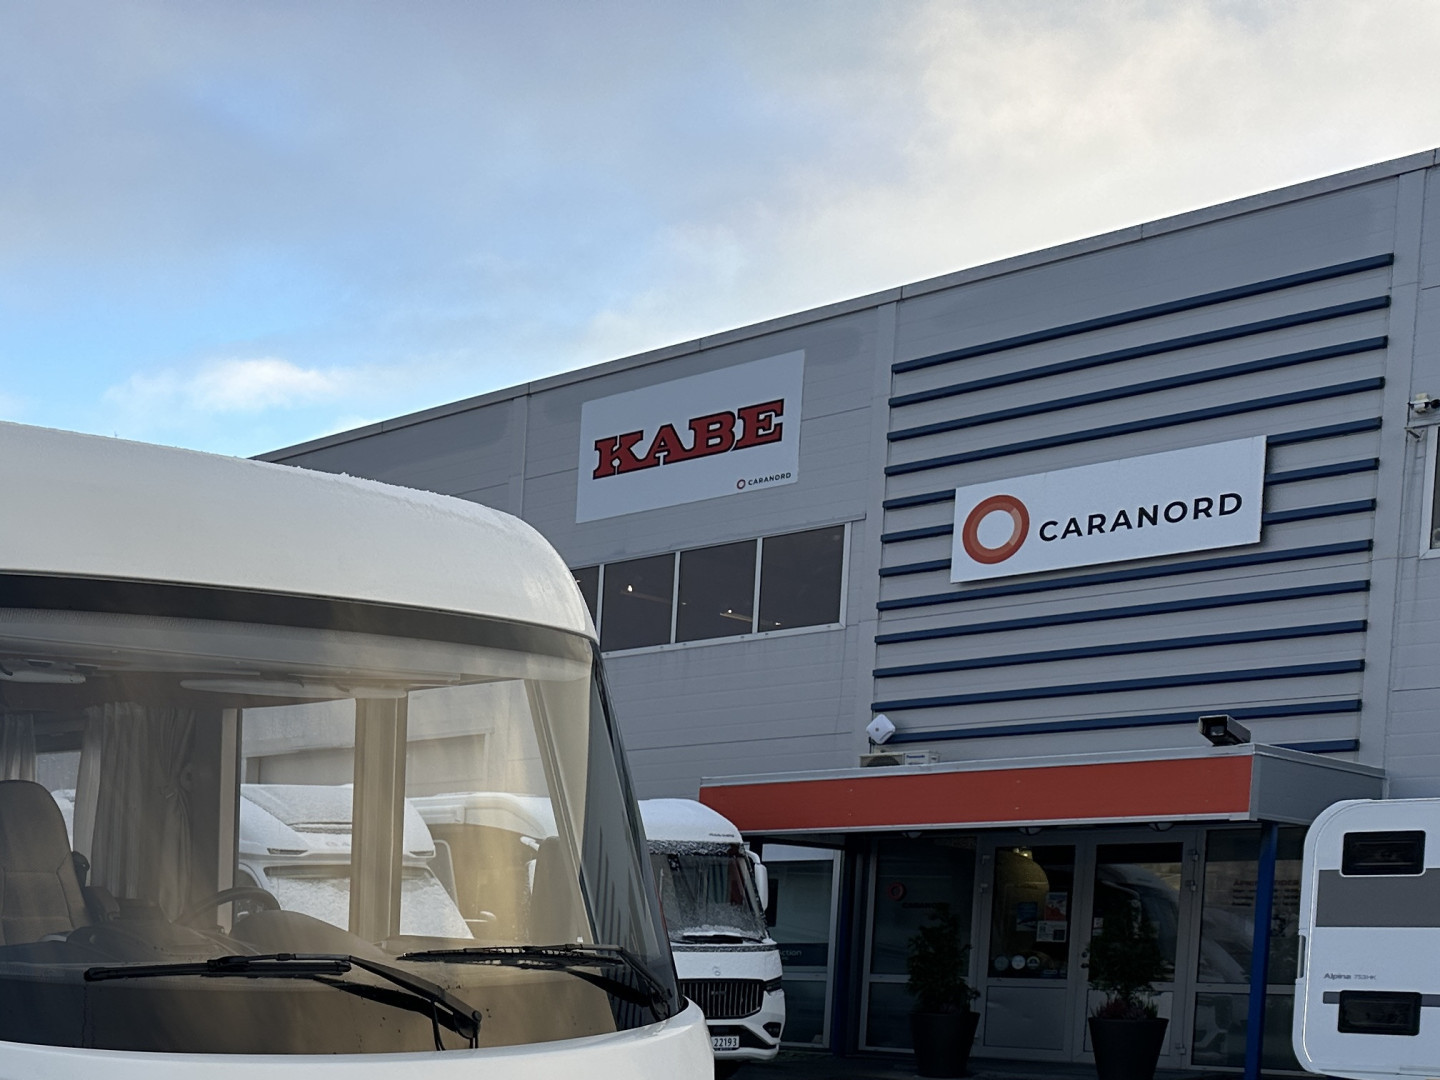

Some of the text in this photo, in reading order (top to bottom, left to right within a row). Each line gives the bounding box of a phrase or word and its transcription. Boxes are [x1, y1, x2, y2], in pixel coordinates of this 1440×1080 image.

[592, 398, 785, 480] KABE
[747, 472, 792, 486] CARANORD
[1038, 492, 1243, 542] CARANORD
[713, 1036, 738, 1048] 22193
